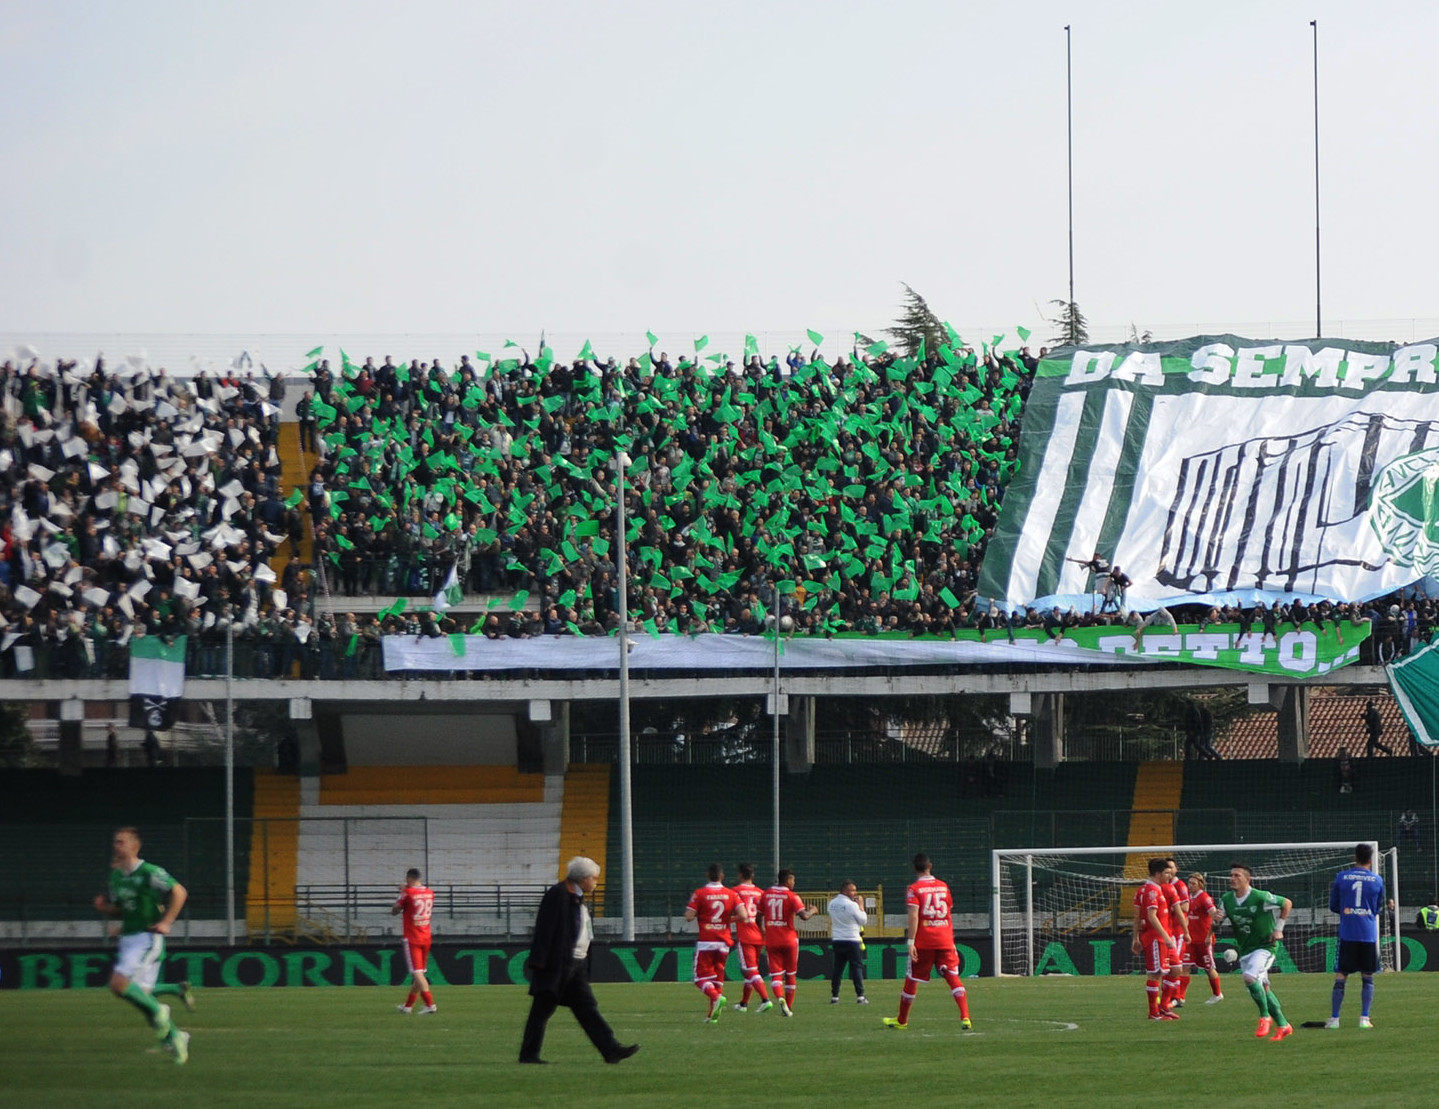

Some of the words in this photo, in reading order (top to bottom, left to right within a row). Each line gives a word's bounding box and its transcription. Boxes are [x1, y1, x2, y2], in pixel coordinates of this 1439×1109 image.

[1065, 350, 1166, 386] DA
[923, 892, 948, 918] 45
[1352, 881, 1363, 907] 1
[413, 899, 434, 920] 28
[711, 901, 725, 923] 2
[768, 899, 784, 920] 11
